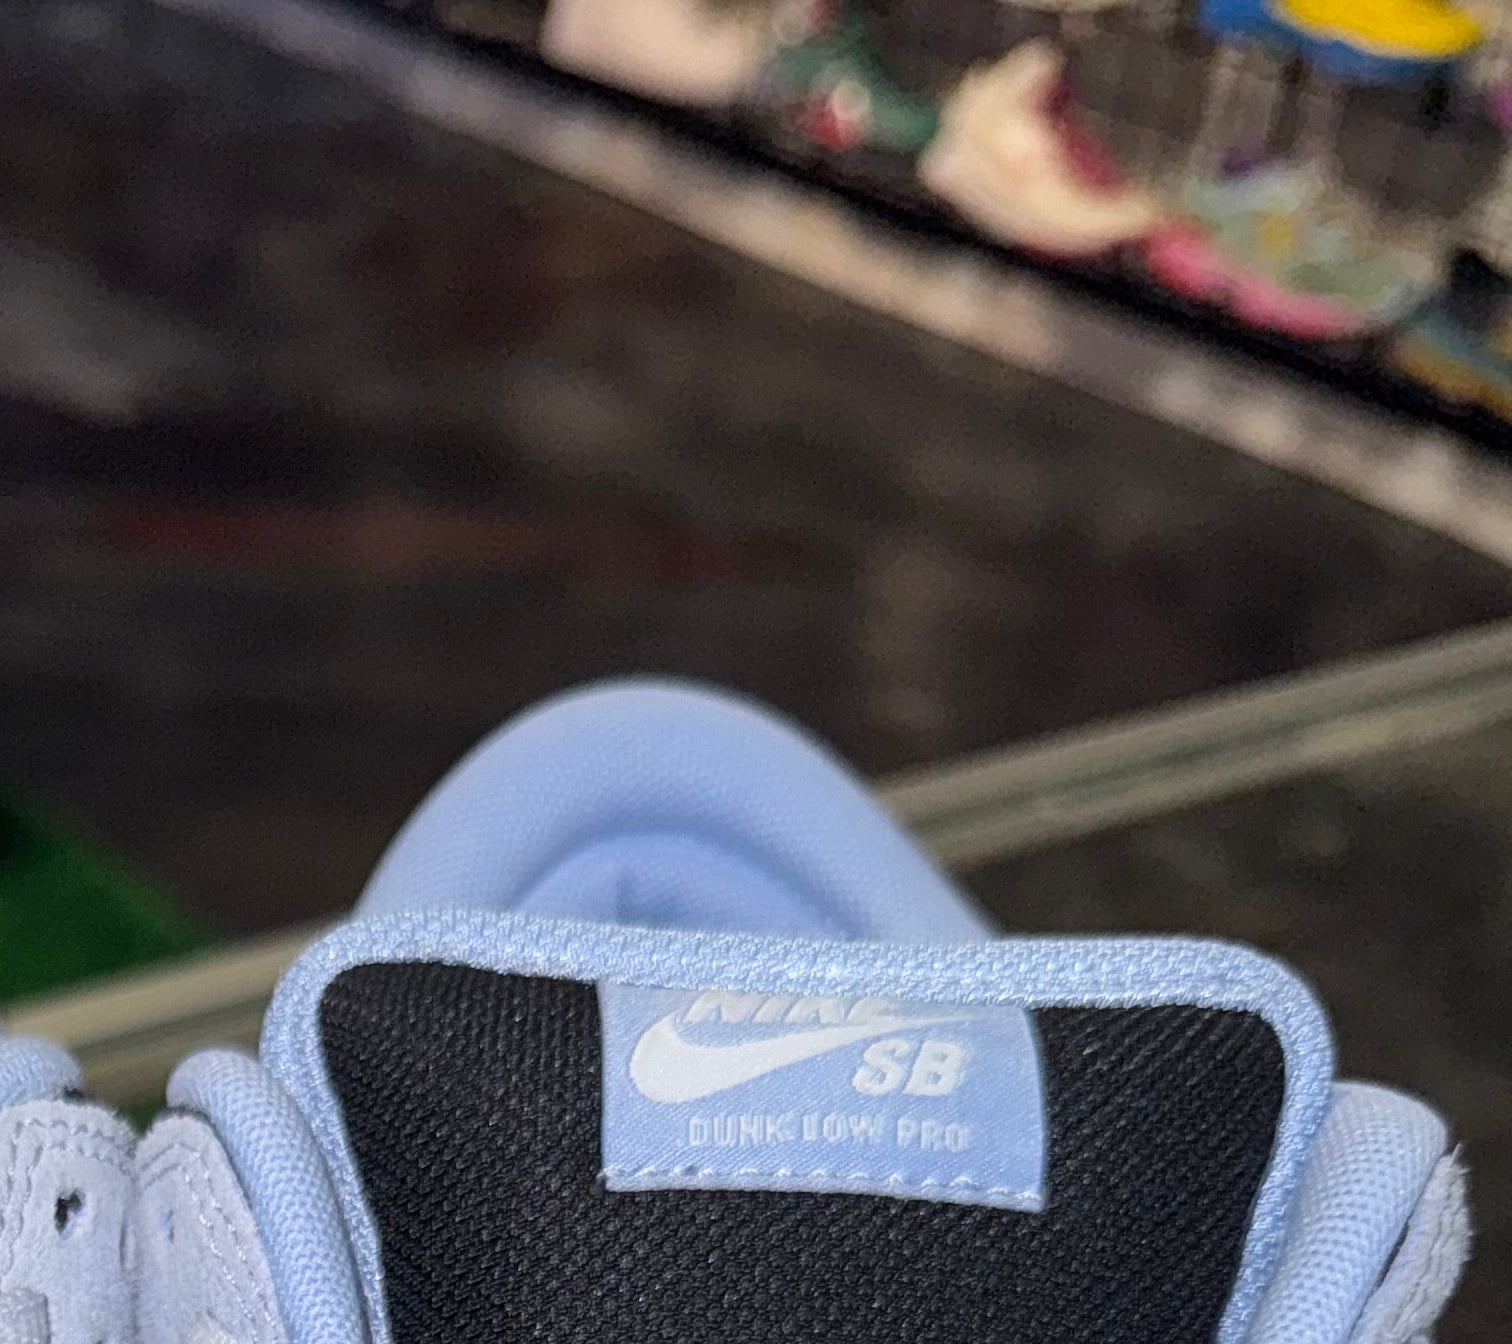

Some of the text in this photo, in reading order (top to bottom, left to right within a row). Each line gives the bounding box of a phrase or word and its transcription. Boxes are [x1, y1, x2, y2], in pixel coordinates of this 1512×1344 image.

[852, 1038, 967, 1096] SB
[688, 1112, 969, 1152] DUNK LOW PRO
